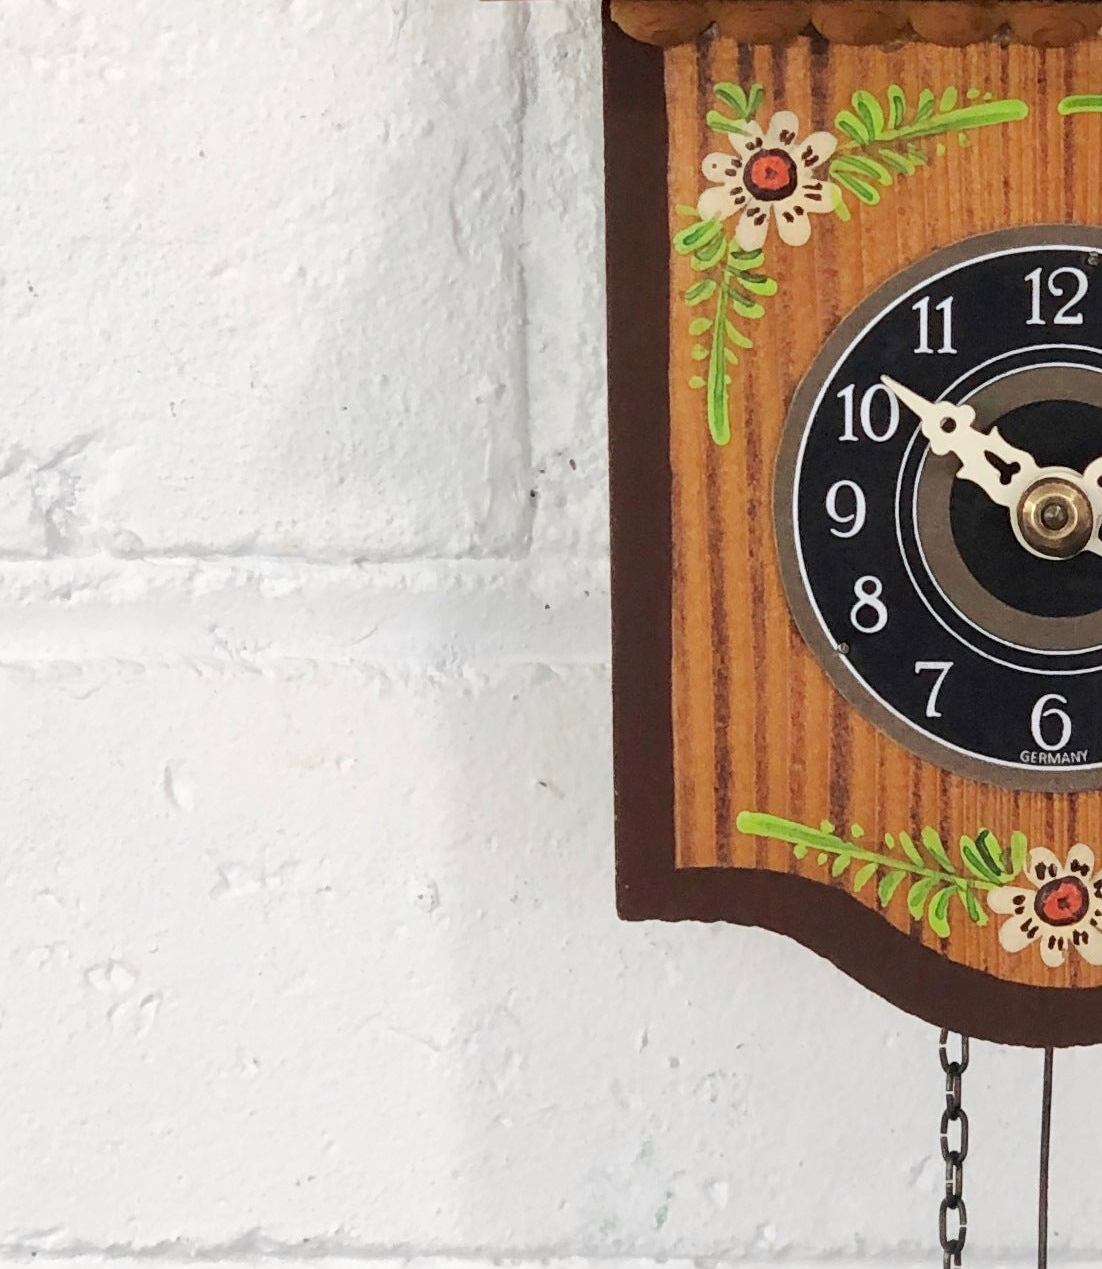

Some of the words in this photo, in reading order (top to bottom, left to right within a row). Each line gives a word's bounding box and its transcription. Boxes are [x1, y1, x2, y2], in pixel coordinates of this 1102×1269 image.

[1024, 267, 1089, 325] 12
[912, 296, 957, 355] 11
[837, 383, 900, 442] 10
[826, 480, 866, 538] 9
[850, 576, 888, 633] 8
[915, 661, 954, 718] 7
[1031, 694, 1071, 751] 6
[1020, 750, 1088, 764] GERMANY
